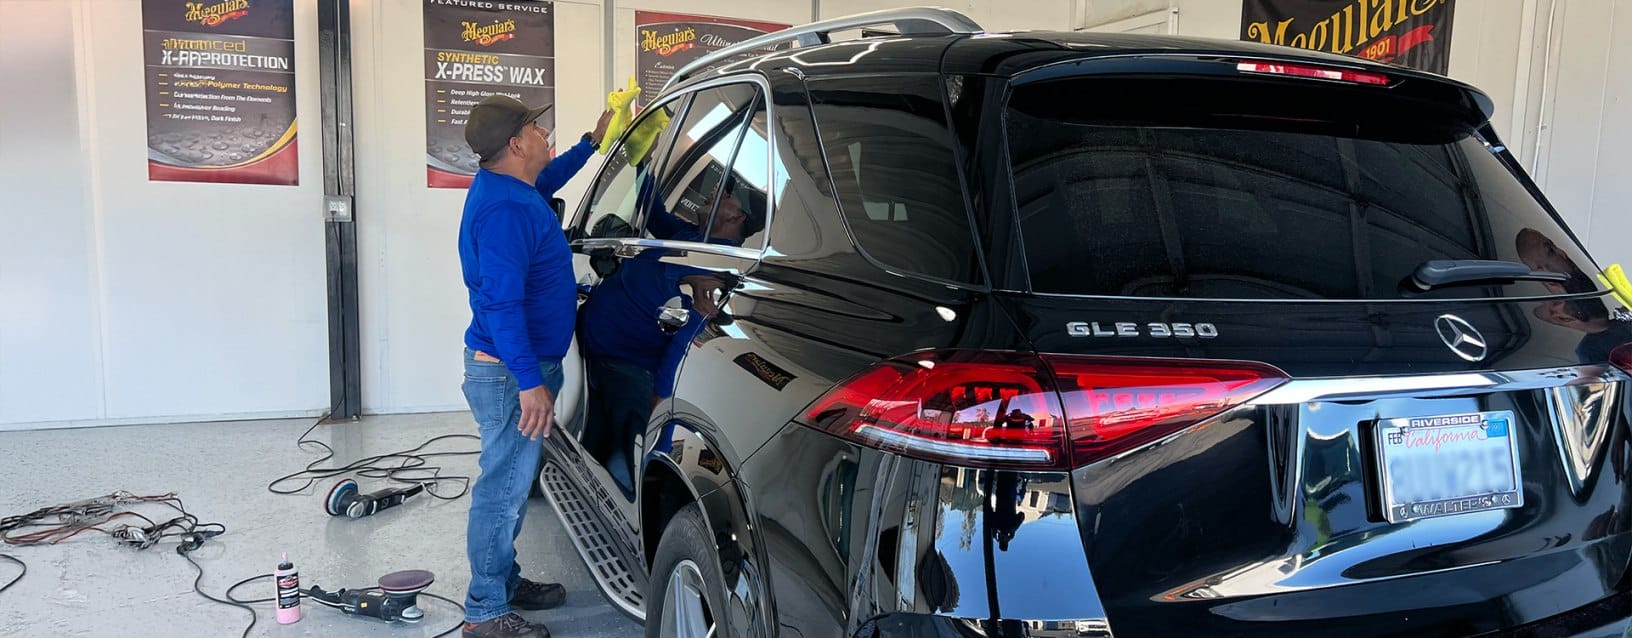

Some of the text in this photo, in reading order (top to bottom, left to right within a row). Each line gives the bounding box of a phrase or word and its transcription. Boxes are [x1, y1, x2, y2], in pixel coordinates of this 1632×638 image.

[185, 0, 249, 24] Meguiars
[498, 4, 548, 13] SERVICE
[461, 19, 516, 45] Meguiar's
[1248, 0, 1440, 54] guiar
[641, 27, 695, 55] Meguiar's
[1366, 39, 1391, 59] 1901
[437, 52, 499, 65] SYNTHETIC
[510, 67, 545, 85] WAX
[207, 80, 240, 89] Polymer
[243, 83, 287, 92] Technology
[1066, 321, 1218, 338] GLE 350
[1411, 415, 1480, 428] RIVERSIDE
[1388, 428, 1489, 453] FEB California
